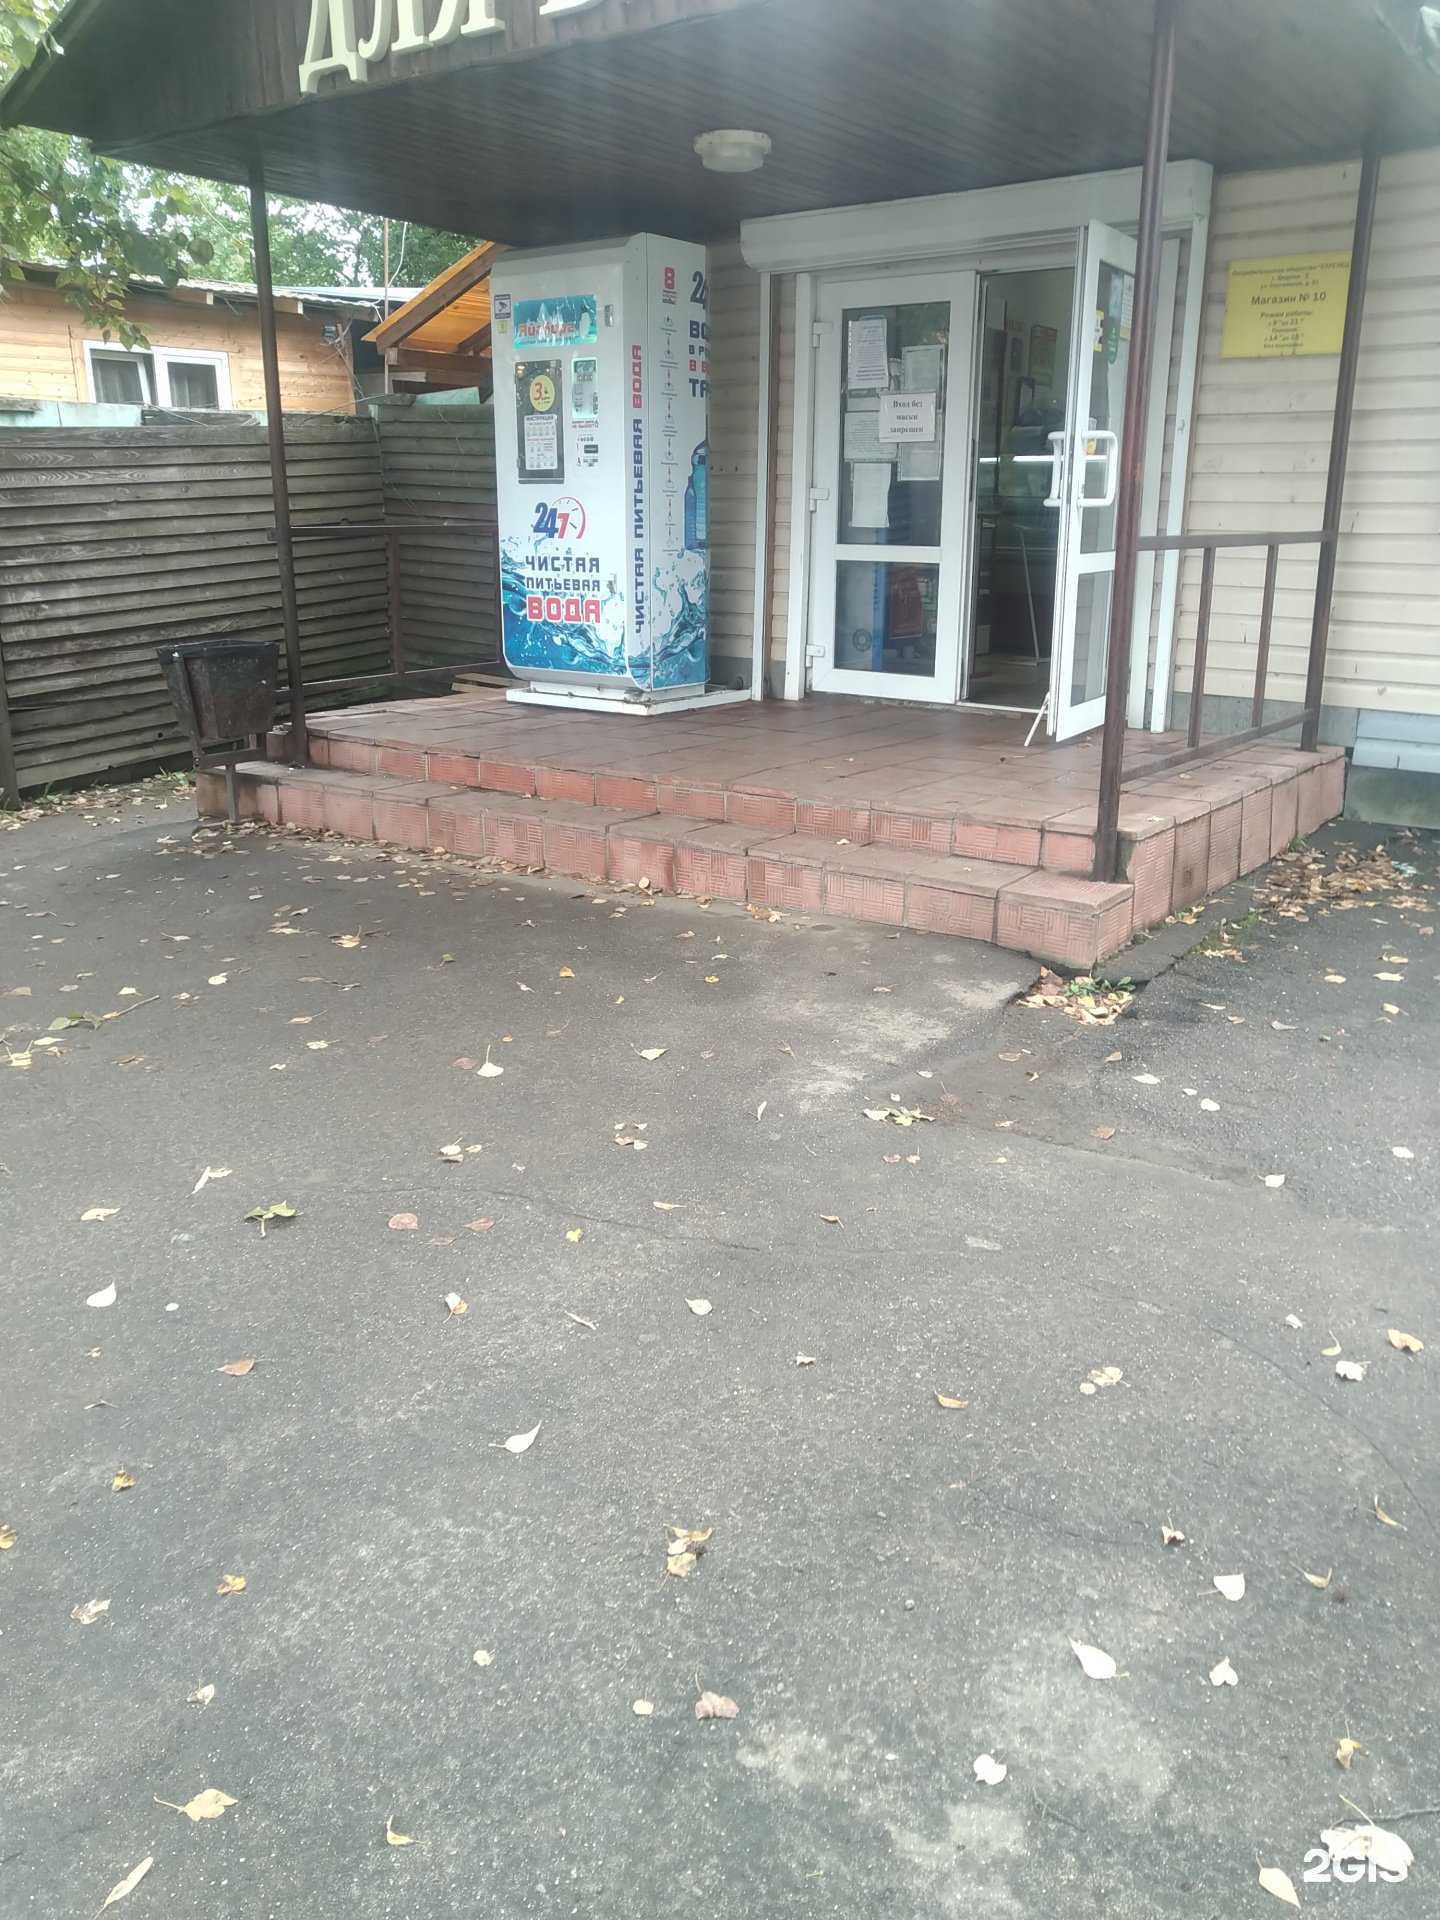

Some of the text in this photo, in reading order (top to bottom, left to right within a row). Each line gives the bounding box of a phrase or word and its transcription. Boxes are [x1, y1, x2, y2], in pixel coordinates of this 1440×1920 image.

[1251, 294, 1296, 305] Магазин
[1313, 291, 1327, 302] 10
[632, 345, 644, 634] ЧИСТАЯ ПИТЬЕВАЯ ВОДА
[525, 555, 600, 573] ЧИСТАЯ
[526, 577, 600, 592] ПИТЬЕВАЯ
[527, 596, 600, 624] ВОДА
